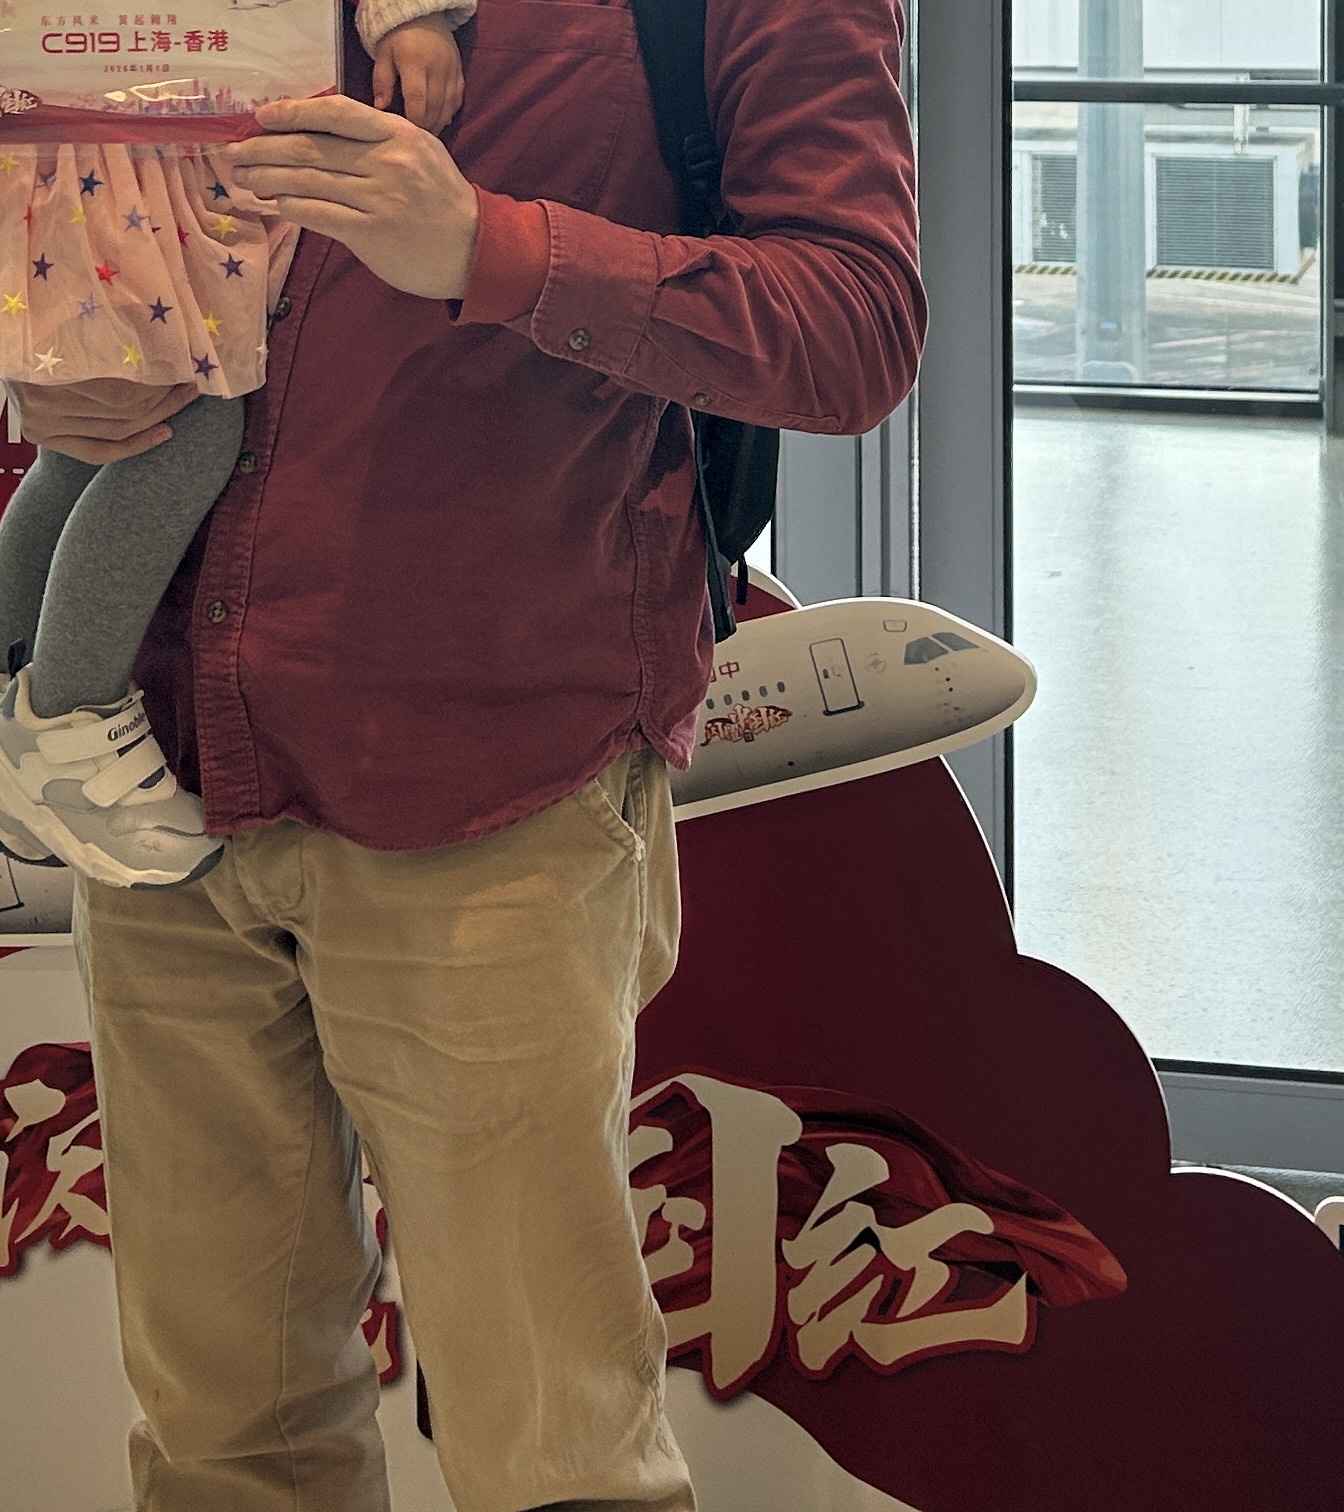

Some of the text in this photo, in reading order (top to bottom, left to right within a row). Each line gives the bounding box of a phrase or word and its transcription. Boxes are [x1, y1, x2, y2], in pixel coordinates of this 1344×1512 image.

[41, 29, 230, 54] C919 上海-香港
